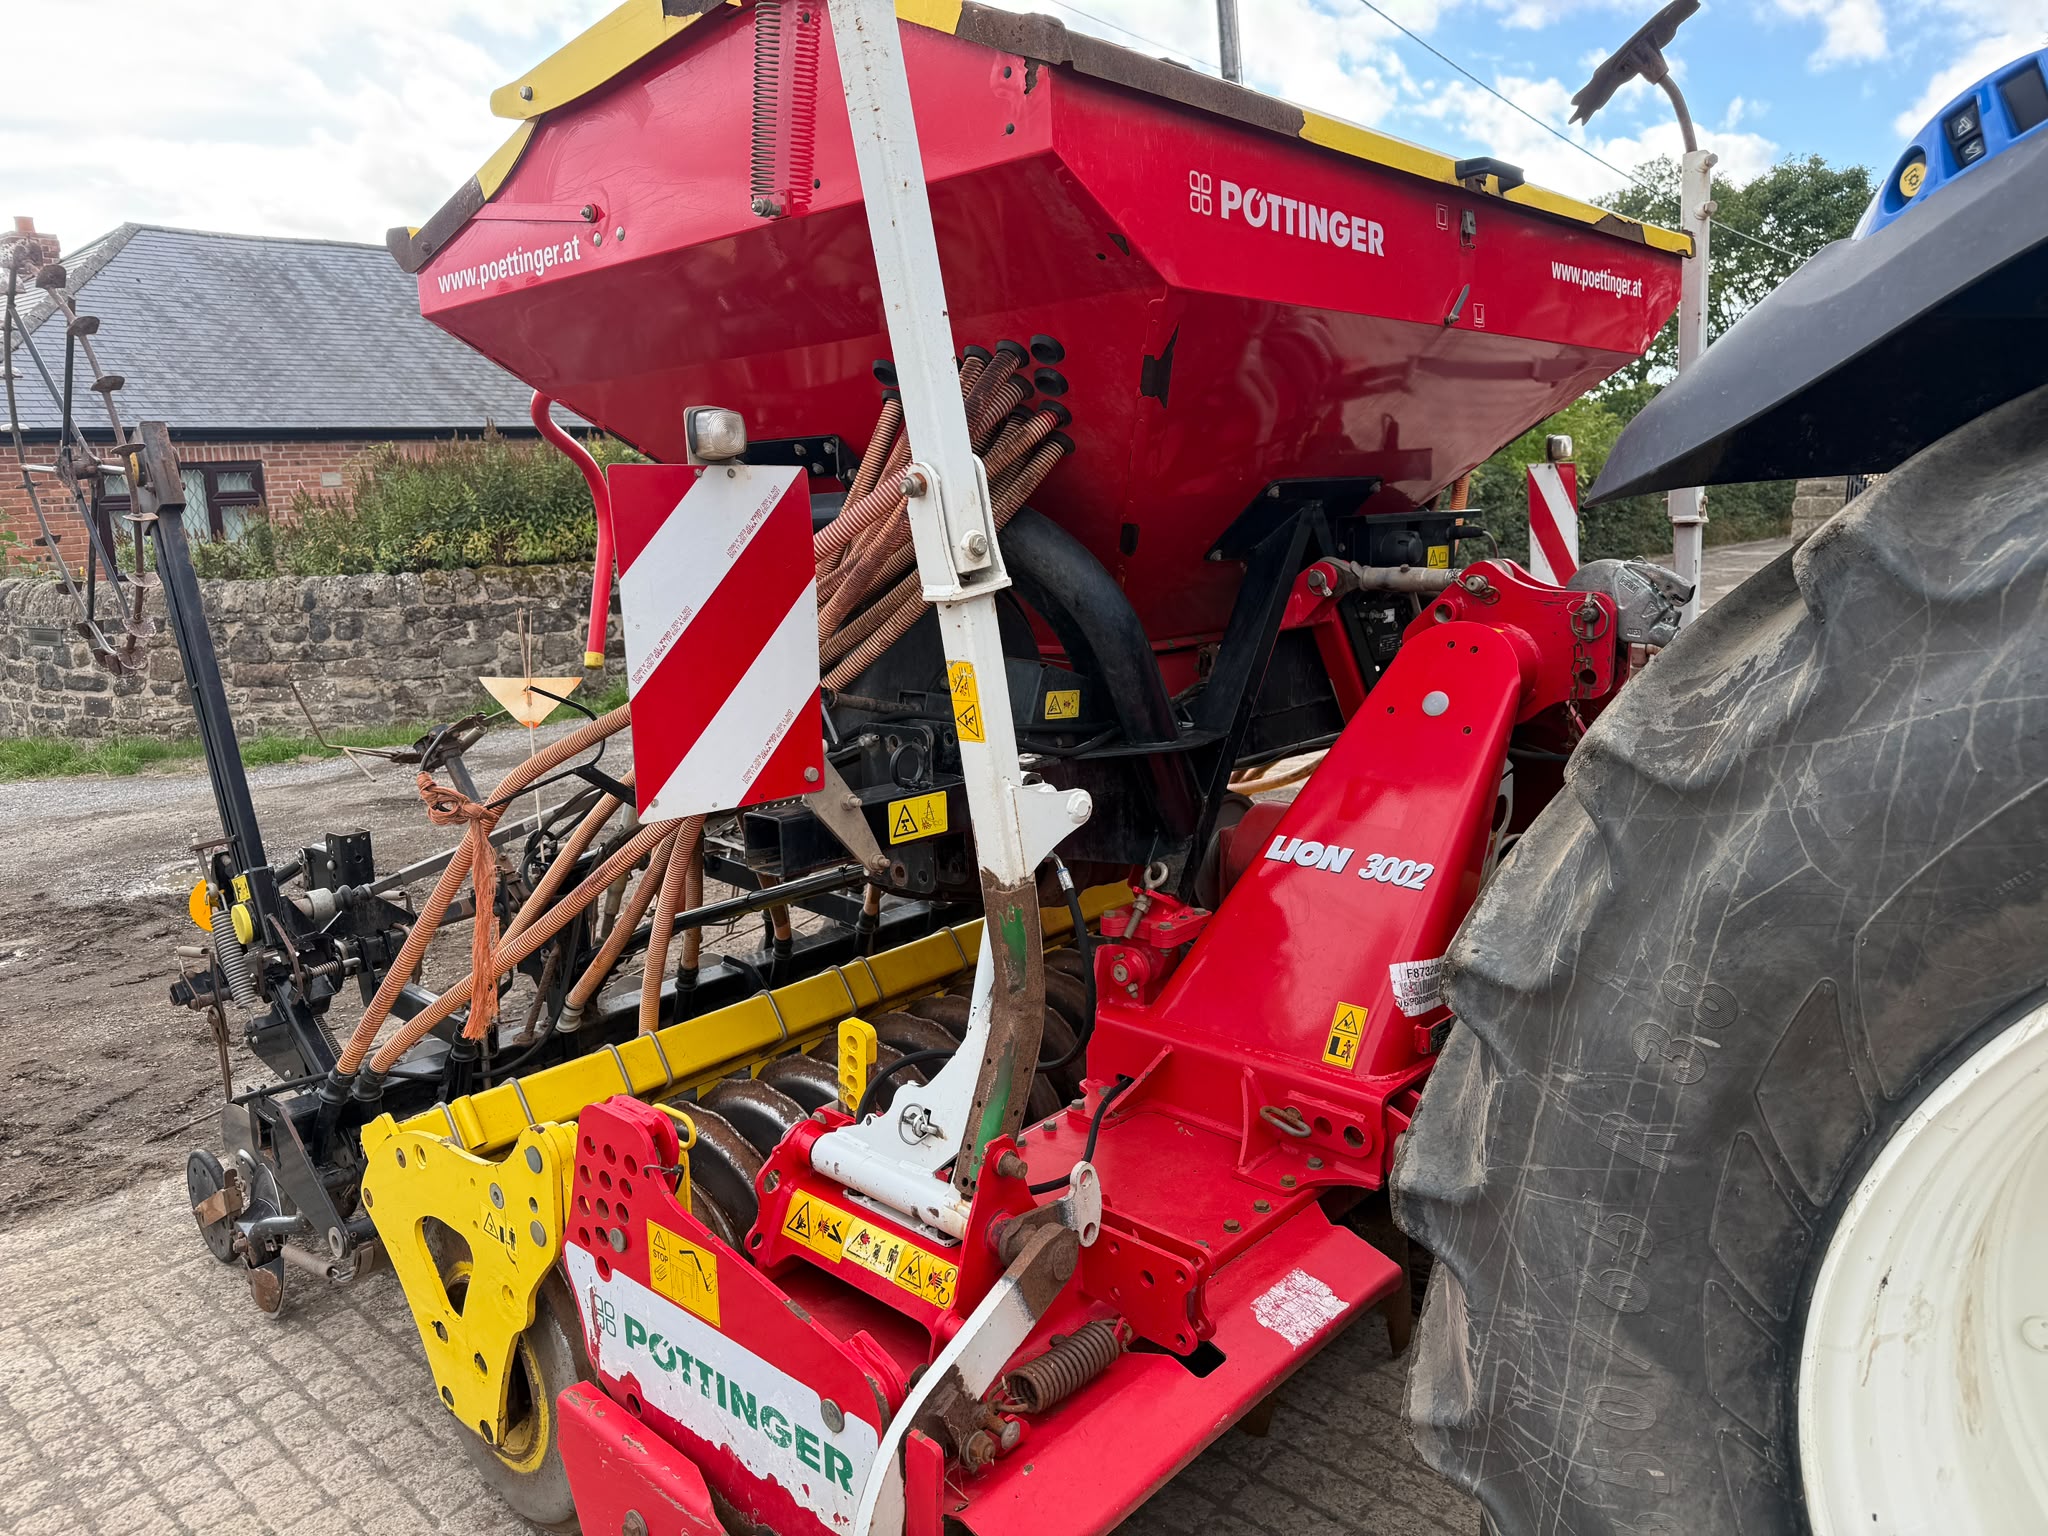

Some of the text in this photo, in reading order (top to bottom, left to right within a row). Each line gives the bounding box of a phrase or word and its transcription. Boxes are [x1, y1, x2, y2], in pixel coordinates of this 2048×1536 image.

[1220, 179, 1385, 257] PÖTTINGER
[437, 234, 581, 294] www.poettinger.at
[1551, 261, 1643, 298] www.poettinger.at
[1264, 834, 1435, 891] LION 3002
[1631, 962, 1738, 1086] 38
[1596, 1111, 1679, 1174] R
[652, 1248, 669, 1263] STOP
[623, 1312, 855, 1497] PÖTTINGER
